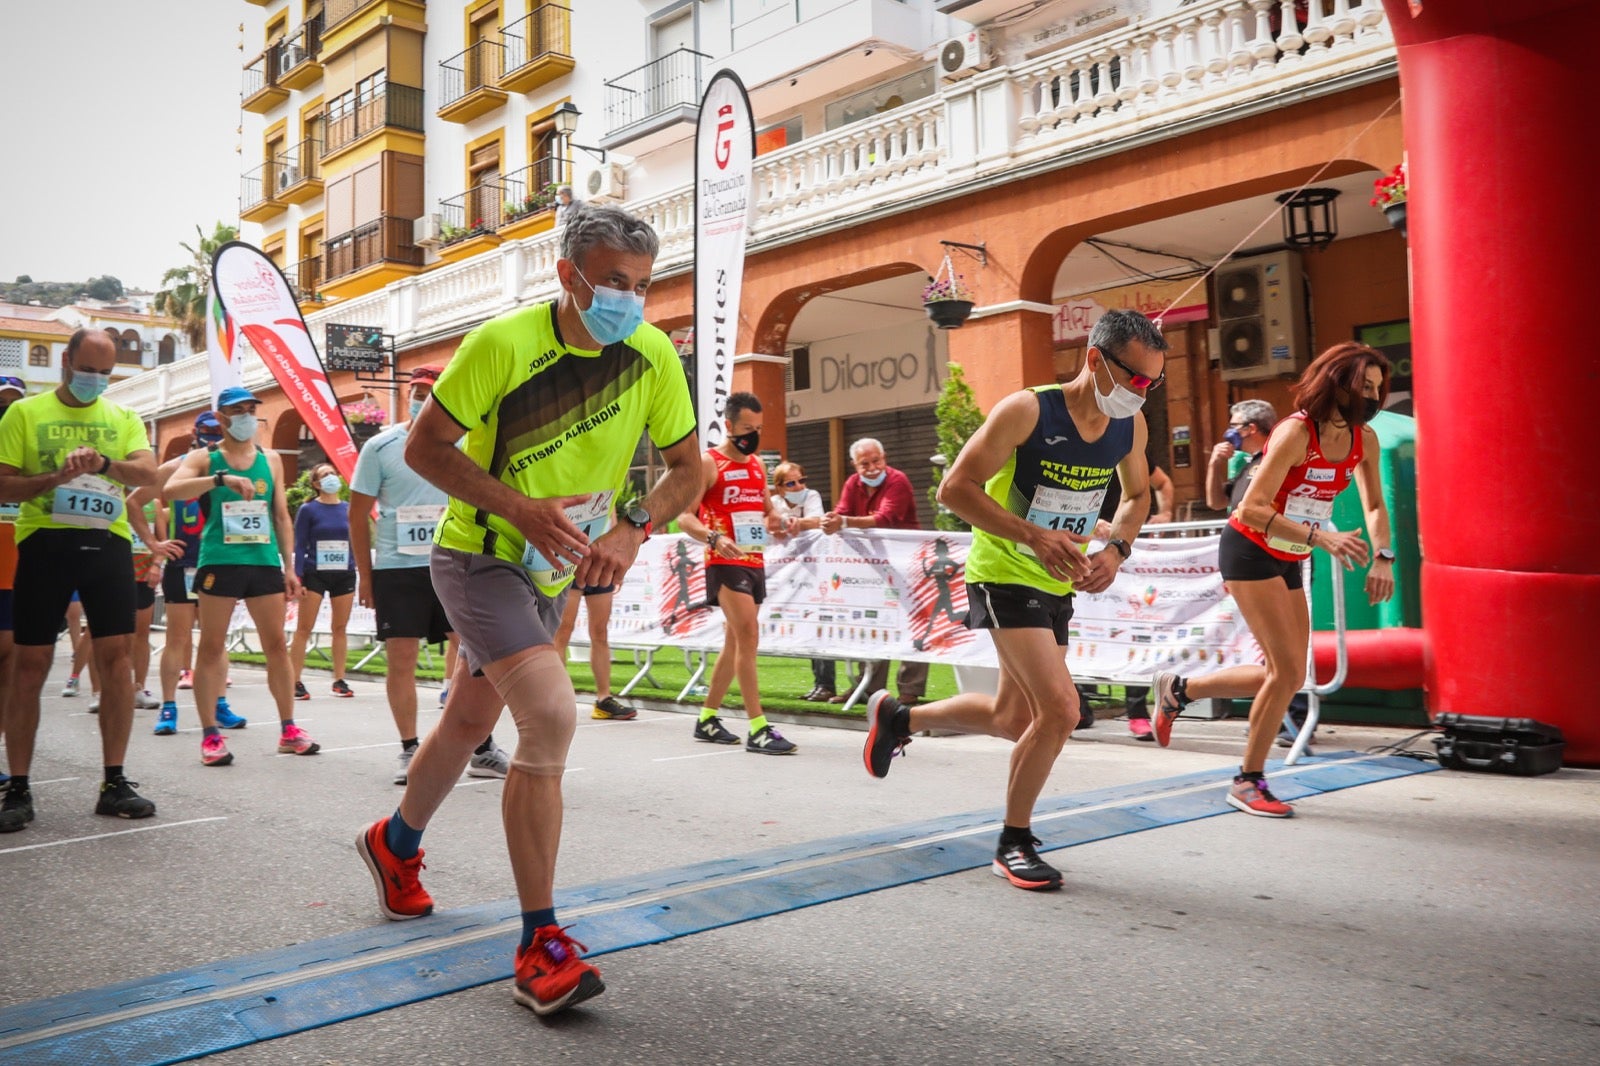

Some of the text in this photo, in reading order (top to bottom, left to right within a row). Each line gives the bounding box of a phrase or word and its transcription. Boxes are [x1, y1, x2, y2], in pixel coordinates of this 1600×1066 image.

[821, 352, 918, 393] Dilargo
[565, 402, 621, 442] ALHENDÍN
[67, 495, 114, 515] 1130
[242, 517, 261, 529] 25
[1048, 516, 1087, 535] 158
[751, 526, 762, 540] 95
[825, 556, 890, 565] GRANADA
